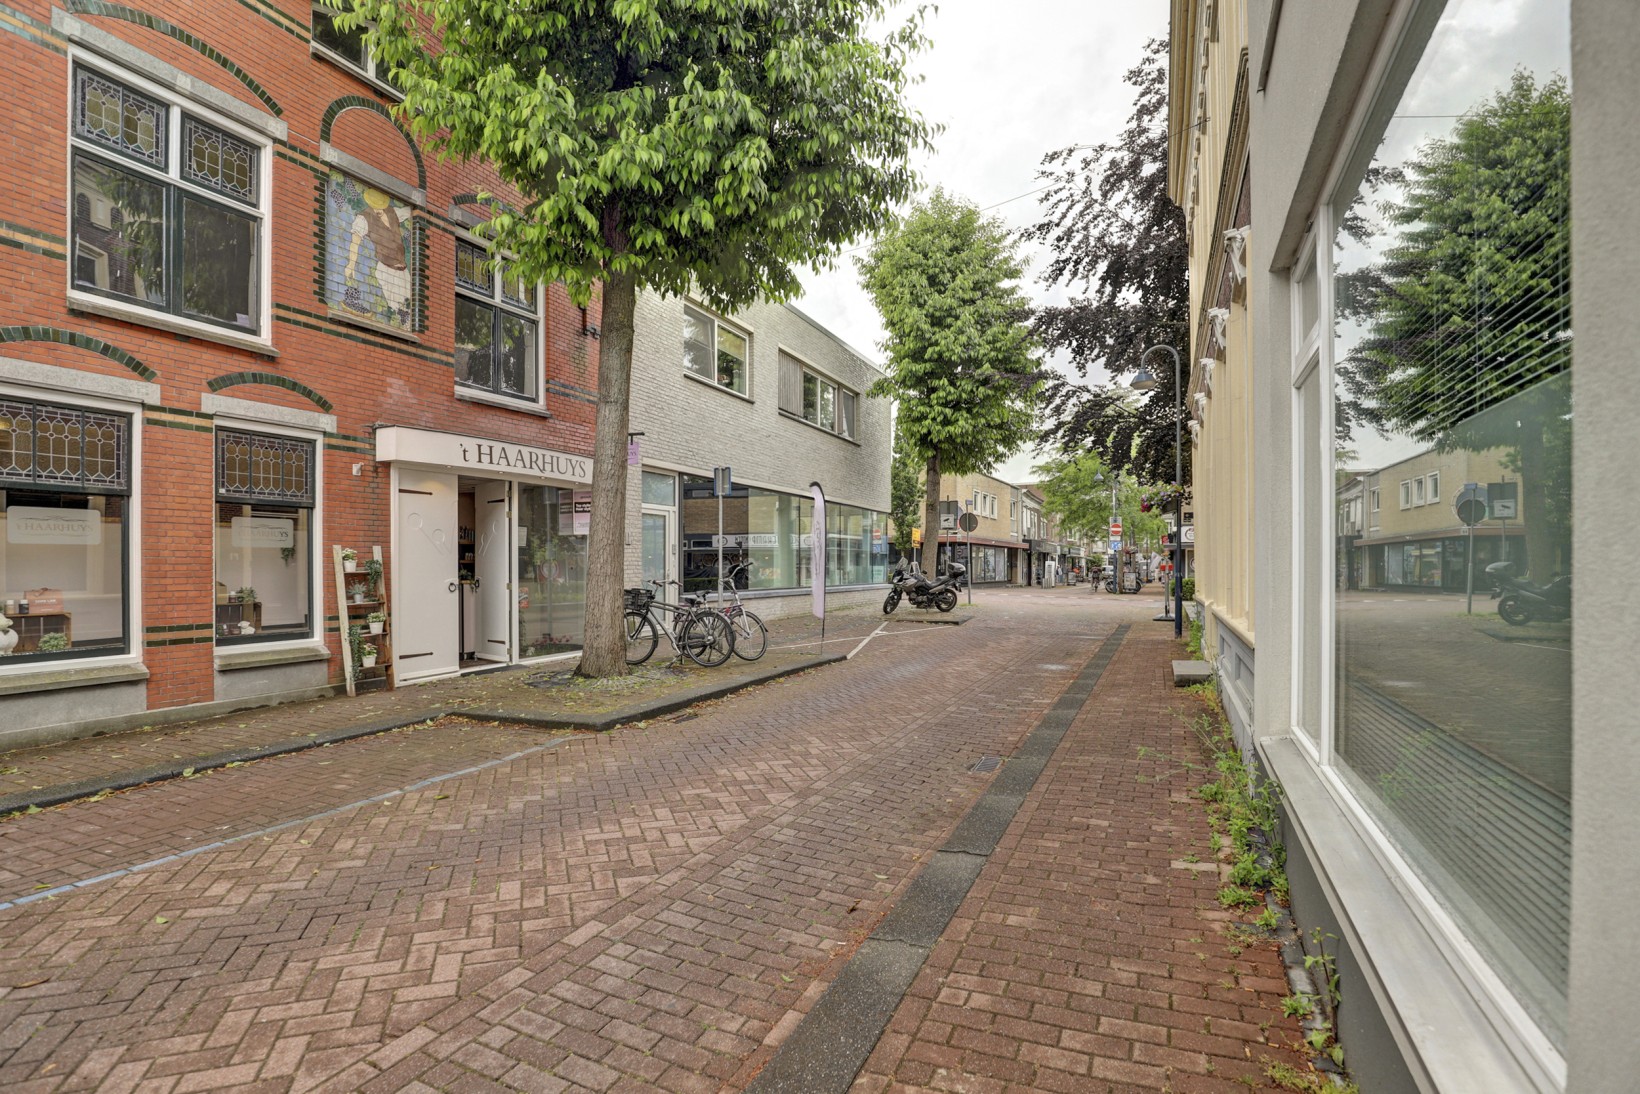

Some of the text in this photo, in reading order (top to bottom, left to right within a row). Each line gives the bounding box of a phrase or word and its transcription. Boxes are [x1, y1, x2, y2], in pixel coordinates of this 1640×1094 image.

[460, 443, 586, 478] 't HAARHUYS
[24, 522, 94, 533] HAARHUYS
